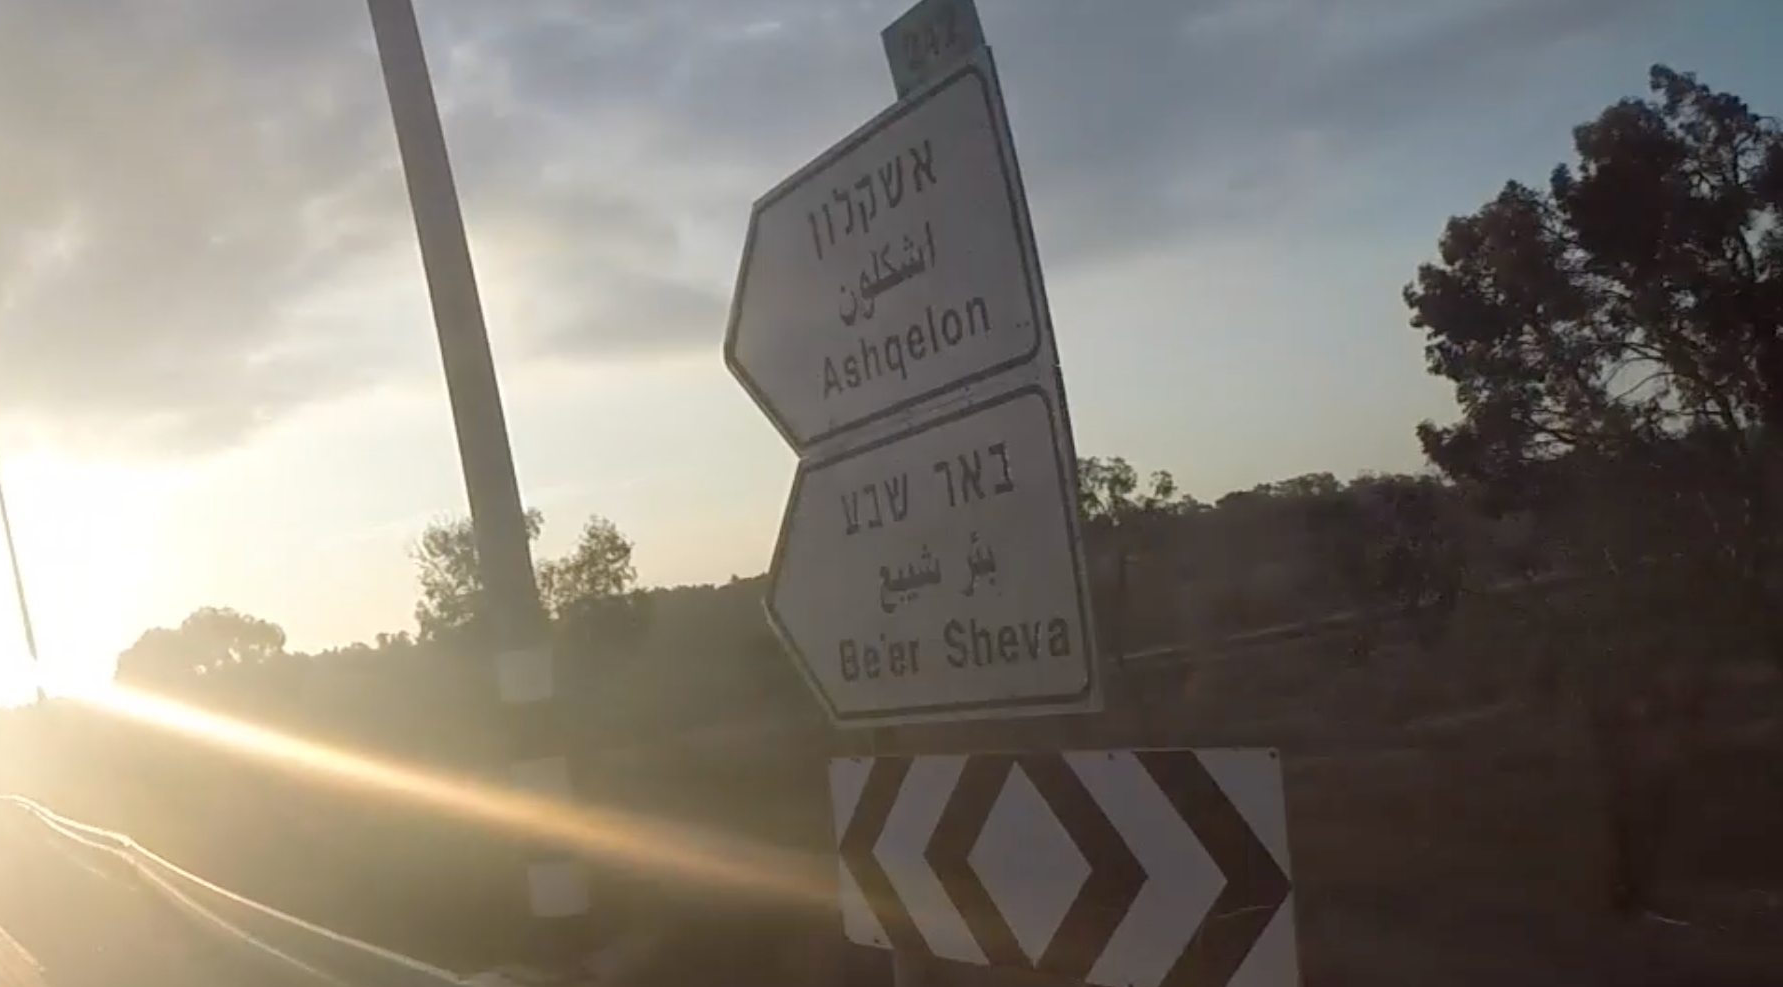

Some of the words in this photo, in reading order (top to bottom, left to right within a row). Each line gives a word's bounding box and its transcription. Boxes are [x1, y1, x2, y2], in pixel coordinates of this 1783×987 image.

[808, 138, 937, 260] אשקלון
[823, 296, 991, 399] Ashqelon
[840, 472, 909, 536] שבע
[934, 440, 1015, 507] באר
[839, 633, 920, 682] Be'er
[943, 617, 1072, 668] Sheva
